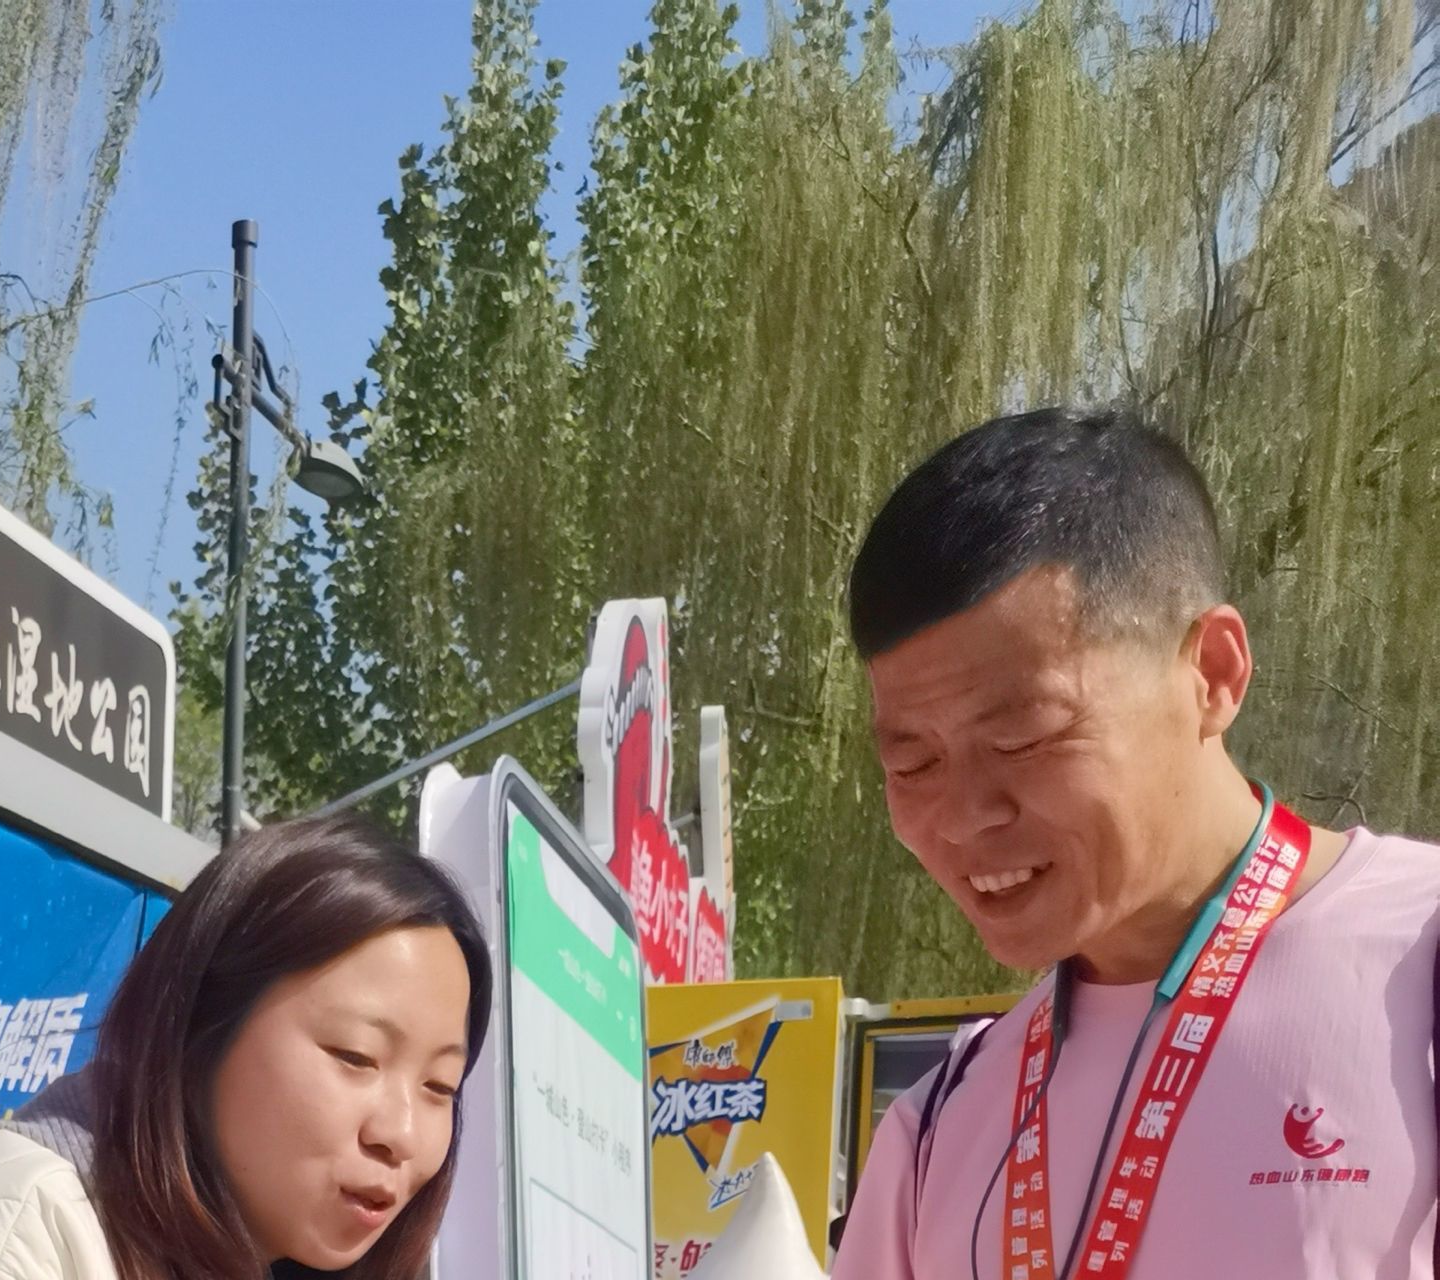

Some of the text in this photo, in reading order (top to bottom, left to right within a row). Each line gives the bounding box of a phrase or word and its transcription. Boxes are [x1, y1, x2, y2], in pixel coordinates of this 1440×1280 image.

[1189, 832, 1279, 1000] 情义齐鲁公益行
[1213, 842, 1302, 999] 热血山东健康跑
[652, 1079, 767, 1135] 冰红茶
[1135, 1011, 1215, 1143] 第三届
